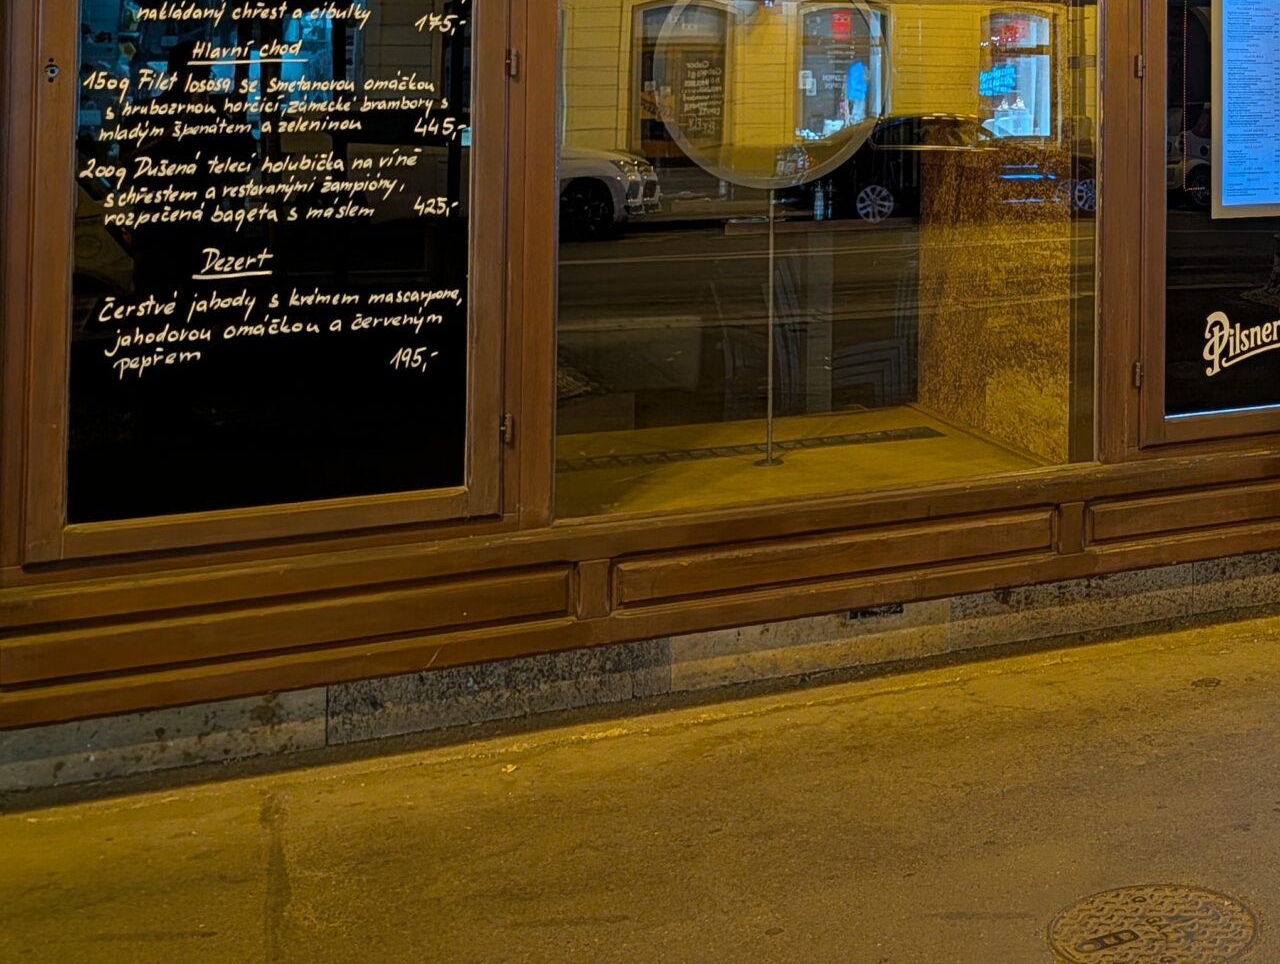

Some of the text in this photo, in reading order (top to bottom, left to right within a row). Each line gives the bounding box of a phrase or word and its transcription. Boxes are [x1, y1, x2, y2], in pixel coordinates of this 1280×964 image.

[136, 1, 372, 30] nakládaný chřest a cibulky
[192, 39, 303, 59] Hlavní chod
[83, 71, 131, 103] 150g
[138, 68, 178, 91] Filet
[184, 72, 231, 93] lososa
[239, 78, 257, 94] se
[363, 71, 435, 92] omáčkou
[105, 107, 114, 120] s
[122, 99, 216, 117] hrubozrnou
[360, 96, 433, 118] brambory
[441, 98, 449, 109] s
[99, 116, 362, 147] mladým špenátem a zeleninou
[79, 148, 422, 189] 200g Dušená telecí holubička na víně
[104, 192, 114, 207] s
[118, 184, 198, 207] chřestem
[205, 186, 216, 199] a
[222, 175, 317, 202] restovanými
[104, 197, 375, 232] rozpečená bageta s máslem
[202, 247, 274, 274] Dezert
[98, 290, 178, 322] Čerstvé
[187, 288, 256, 323] jahody
[268, 293, 279, 308] s
[289, 287, 360, 307] krémem
[104, 307, 443, 357] jahodovou omáčkou a červeným
[113, 347, 201, 380] pepřem
